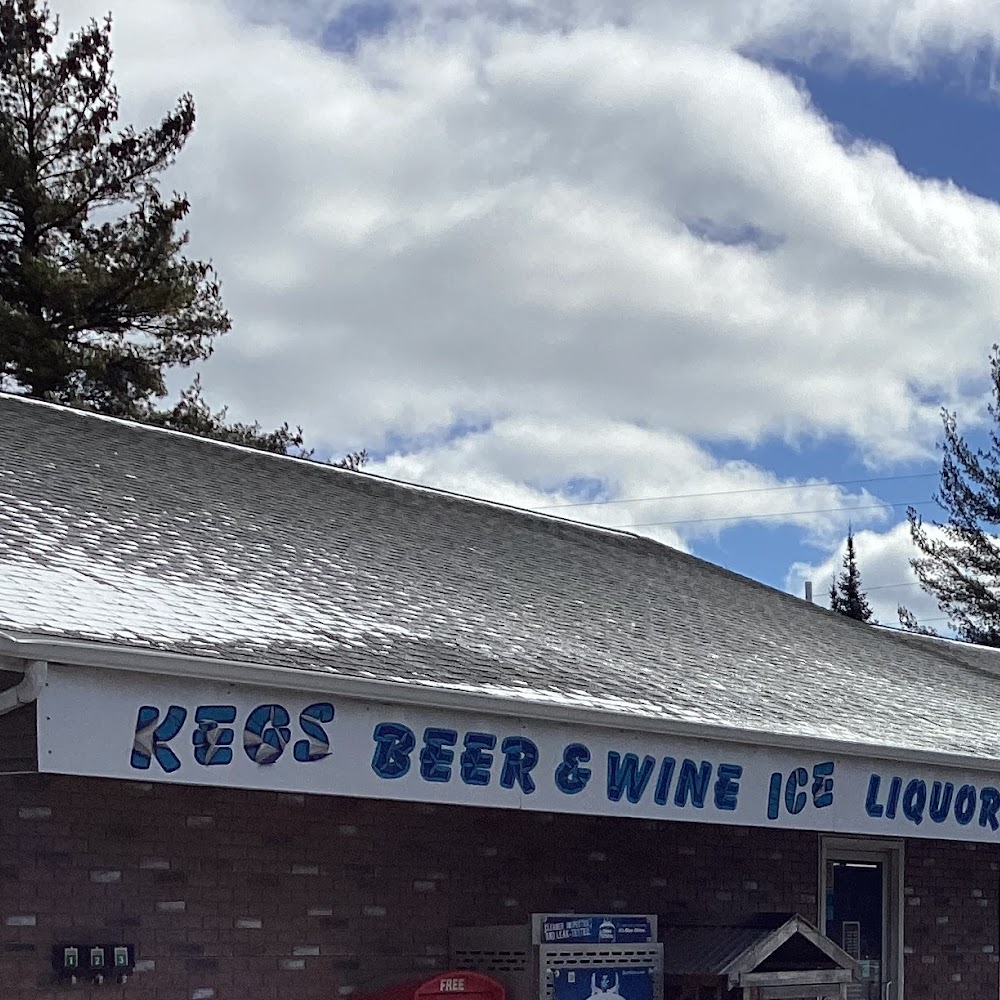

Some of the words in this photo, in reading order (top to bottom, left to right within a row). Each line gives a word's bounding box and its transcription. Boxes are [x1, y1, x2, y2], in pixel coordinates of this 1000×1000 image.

[130, 702, 335, 773] KEGS
[371, 722, 539, 794] BEER
[555, 742, 591, 794] &
[607, 751, 743, 810] WINE
[767, 761, 834, 820] ICE
[864, 773, 1000, 831] LIQUOR
[440, 978, 465, 992] FREE
